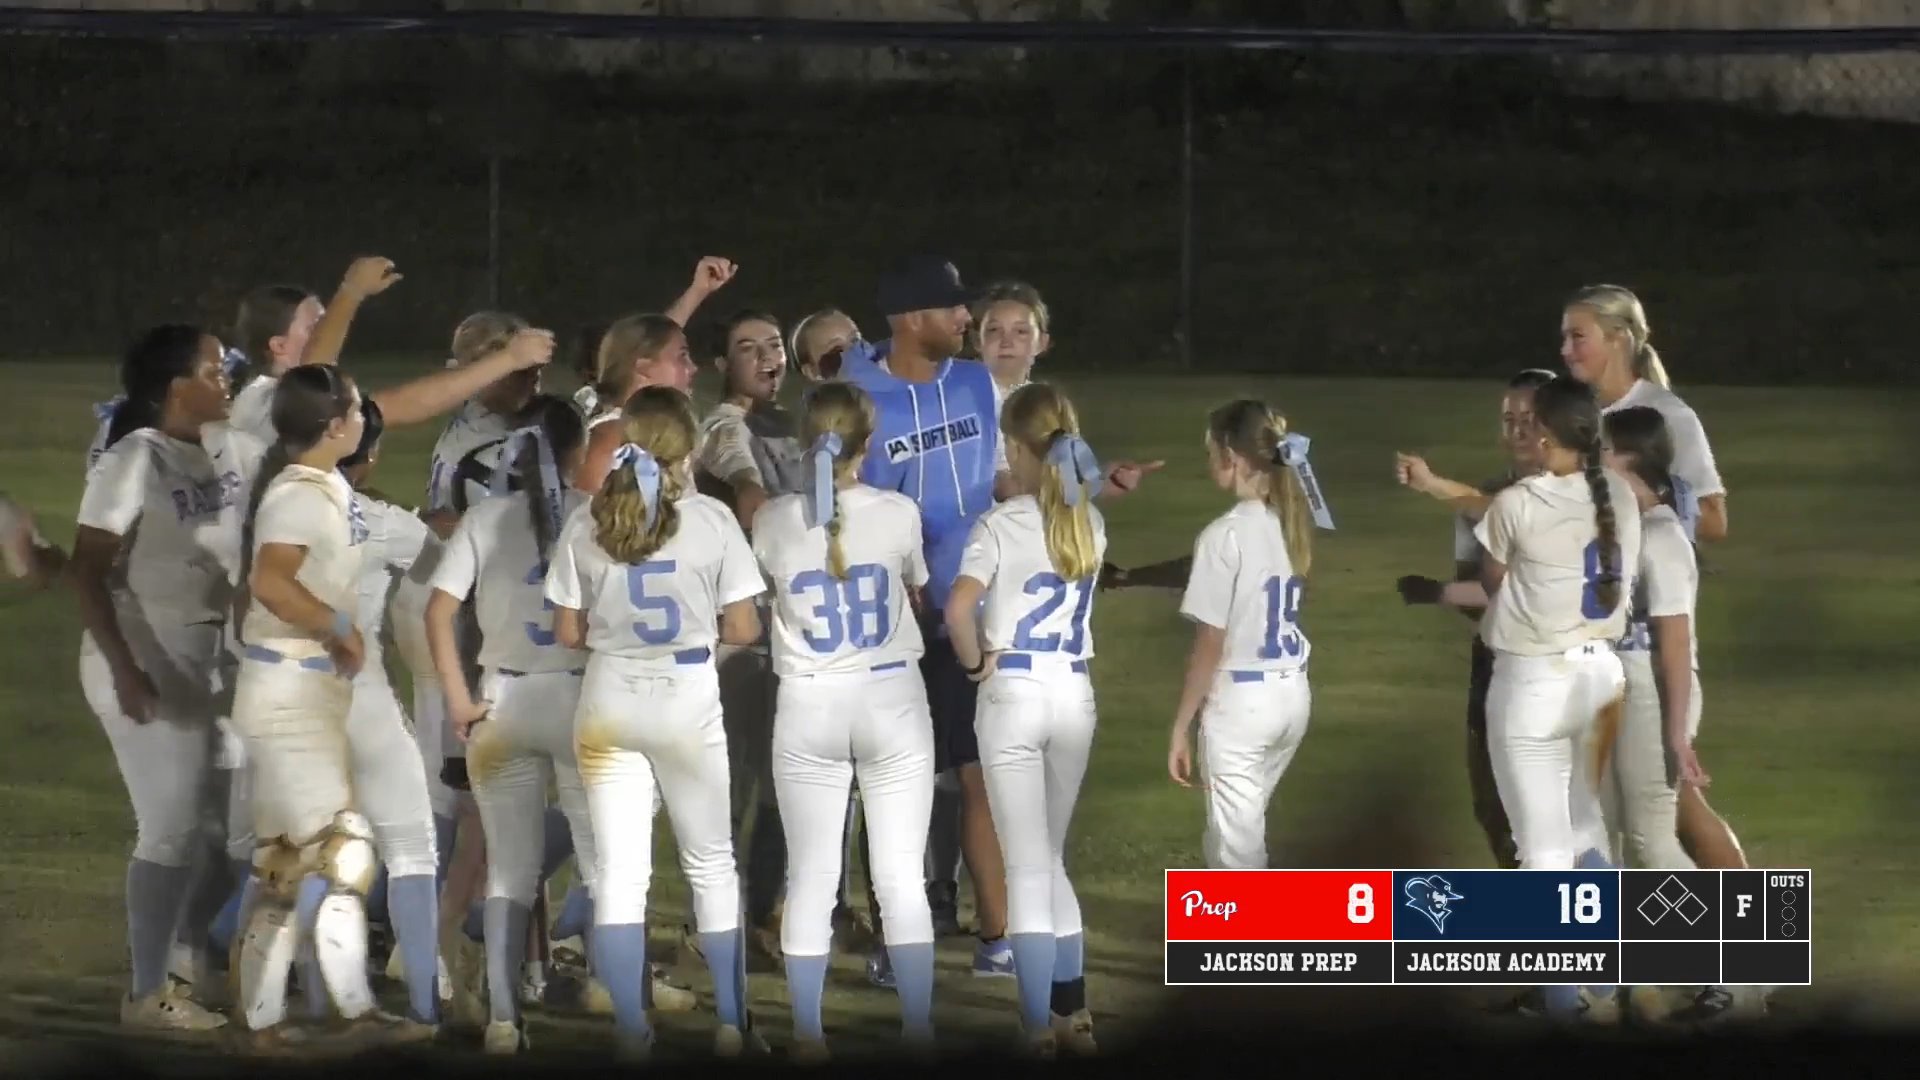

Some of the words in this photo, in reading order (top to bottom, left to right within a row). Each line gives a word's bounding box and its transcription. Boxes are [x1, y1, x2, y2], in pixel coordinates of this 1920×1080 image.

[909, 416, 980, 454] SOFTBALL
[627, 559, 681, 645] 5
[789, 563, 889, 653] 38
[1012, 571, 1095, 657] 21
[1256, 574, 1306, 660] 19
